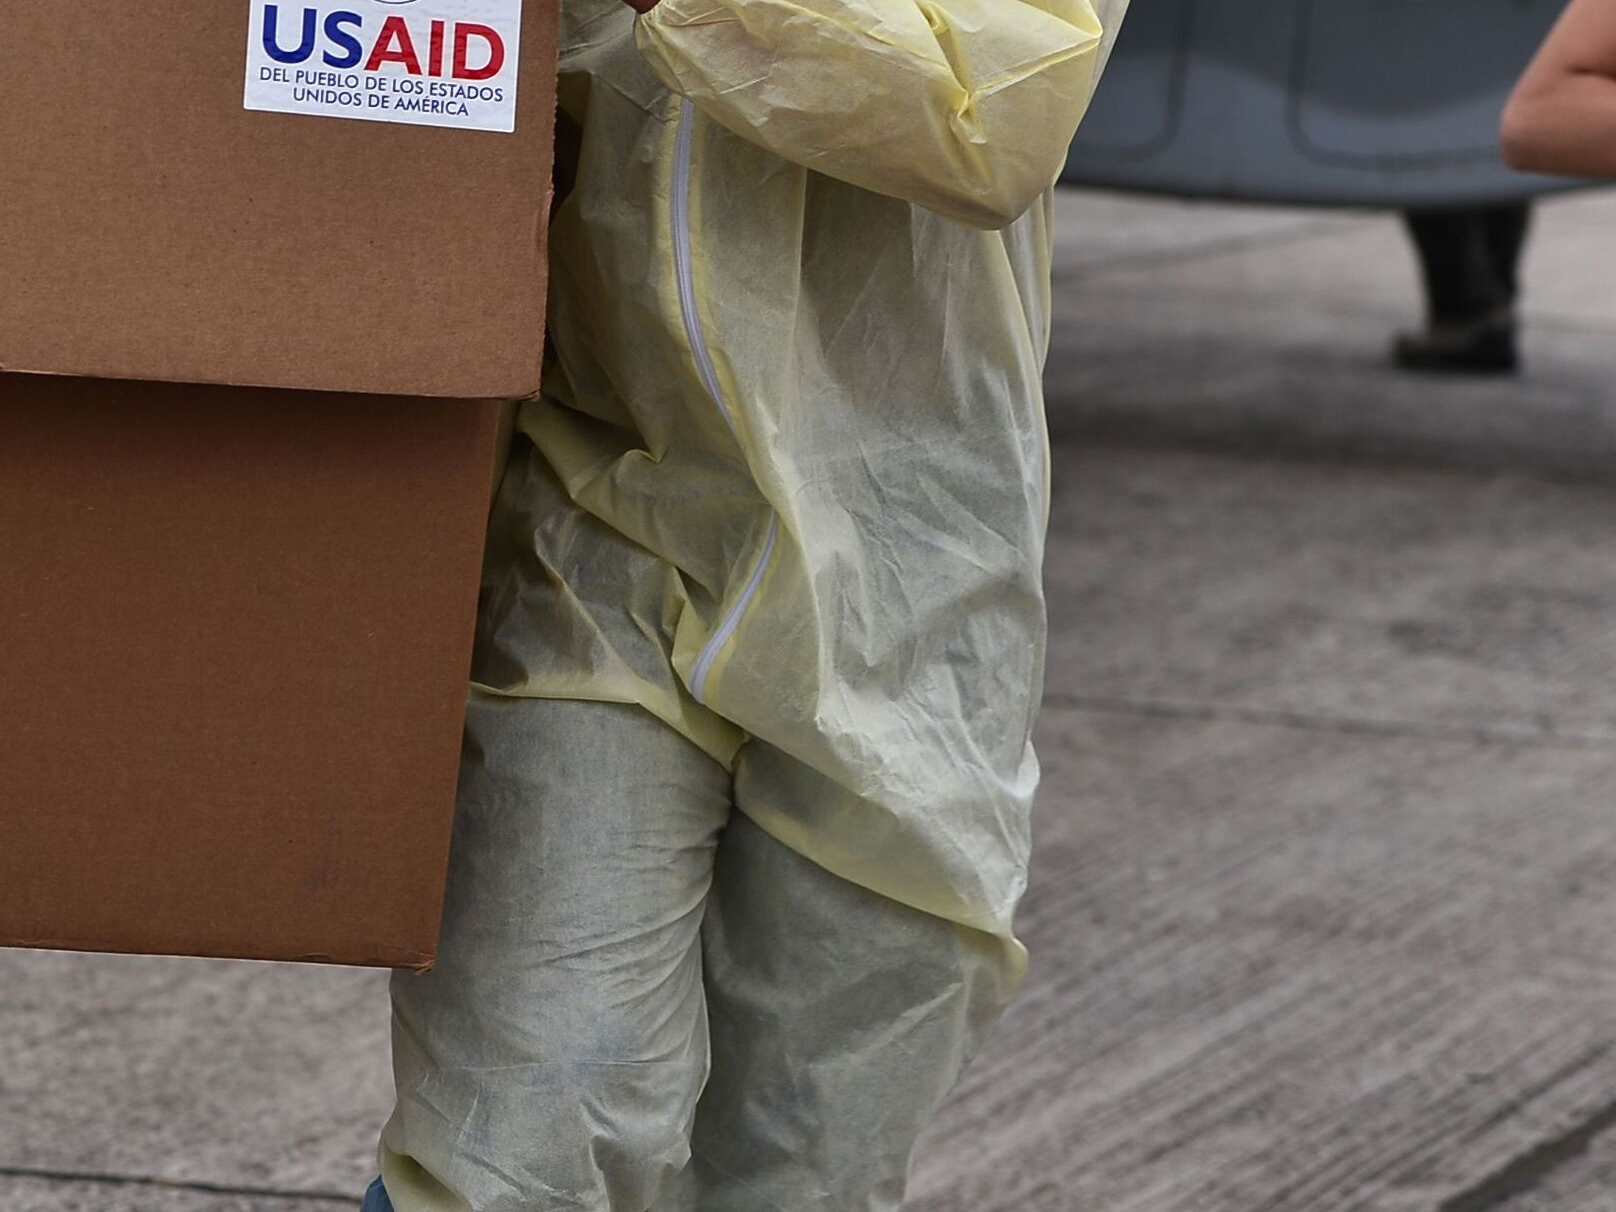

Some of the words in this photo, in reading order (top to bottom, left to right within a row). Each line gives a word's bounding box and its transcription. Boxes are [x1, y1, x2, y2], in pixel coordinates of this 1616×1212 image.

[262, 4, 505, 81] USAID
[260, 67, 290, 83] DEL
[295, 70, 359, 89] PUEBLO
[365, 76, 385, 92] DE
[392, 79, 424, 95] LOS
[429, 82, 503, 103] ESTADOS
[293, 88, 362, 107] UNIDOS
[368, 94, 390, 109] DE
[394, 95, 469, 117] AMÉRICA
